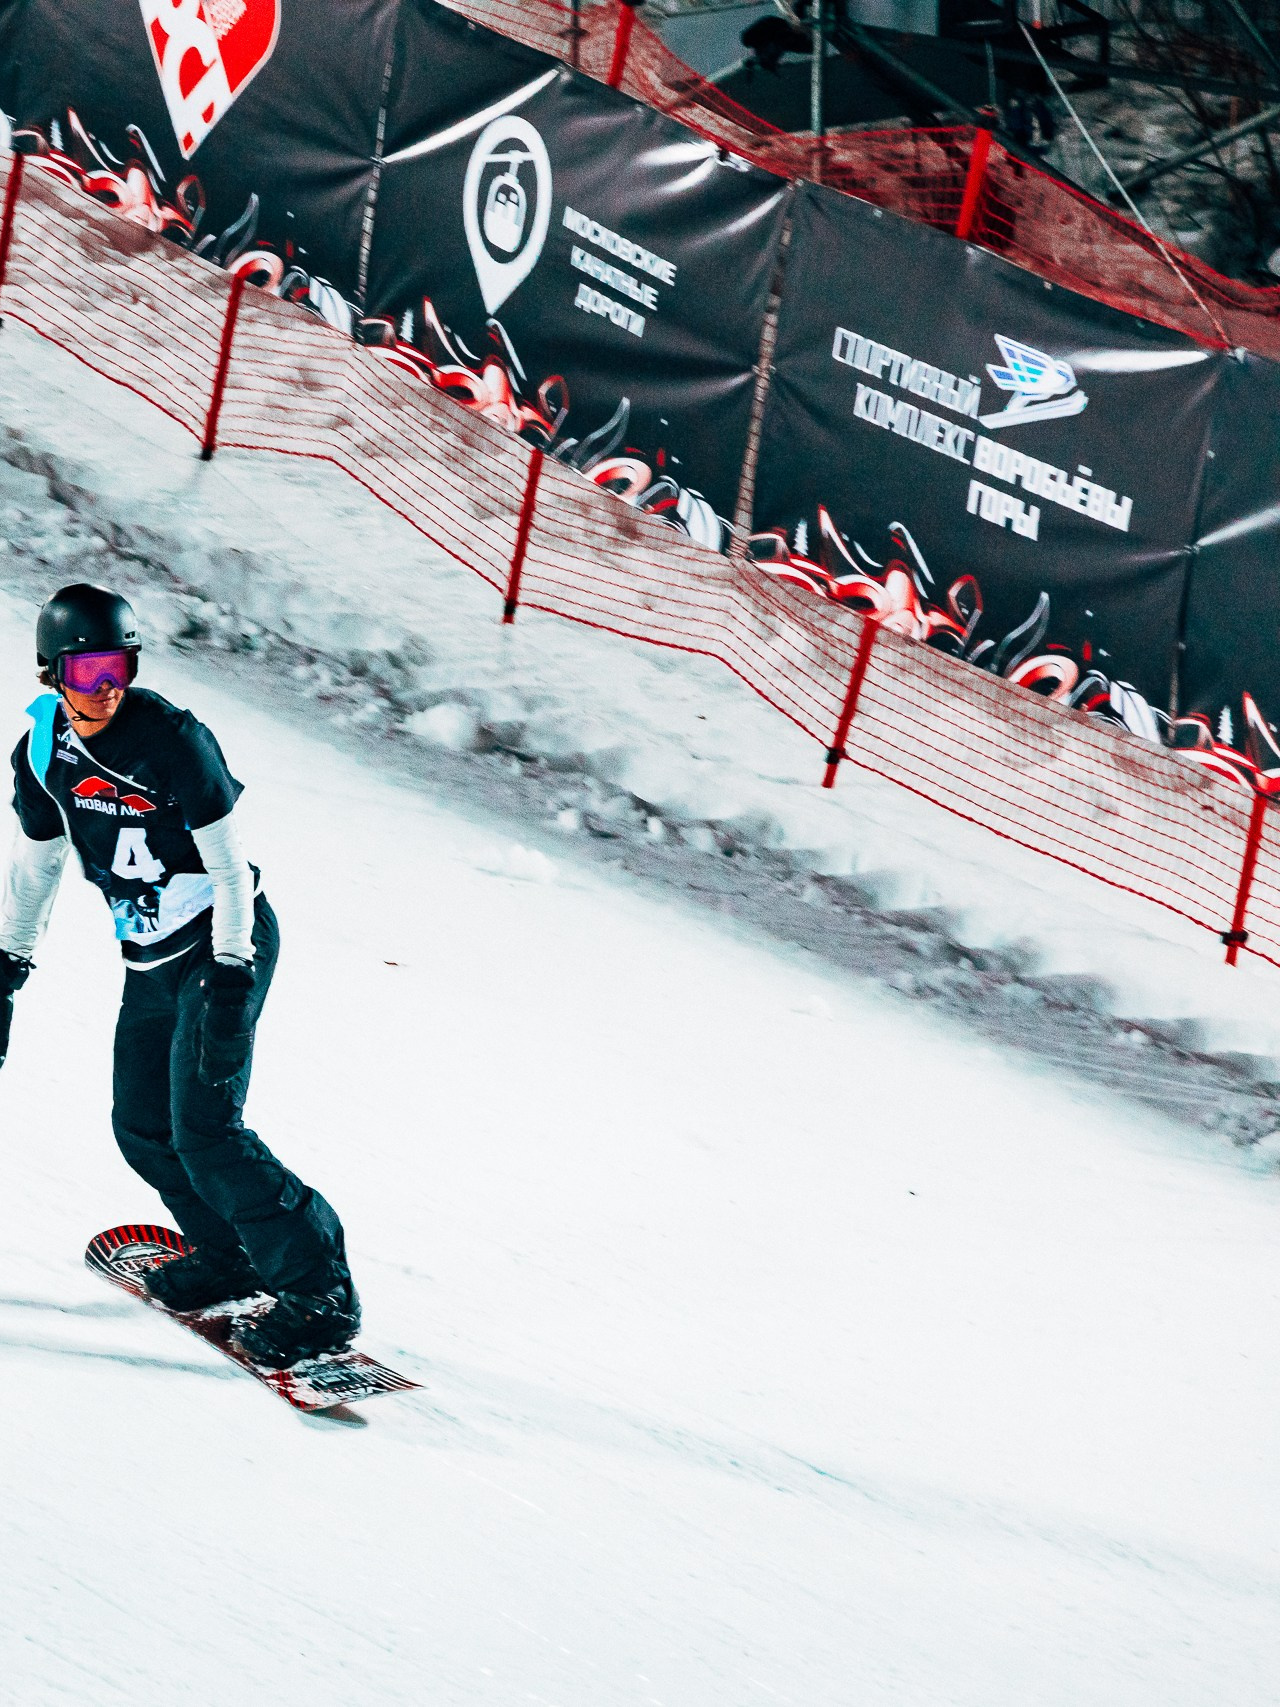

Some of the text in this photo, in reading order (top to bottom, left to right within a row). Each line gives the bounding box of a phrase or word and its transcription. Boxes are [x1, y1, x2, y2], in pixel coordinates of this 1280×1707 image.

[562, 206, 677, 286] МОСКОВСКИЕ
[574, 282, 646, 338] ДОРОГИ
[832, 326, 982, 420] СПОРТИВНЫЙ
[853, 382, 1134, 532] КОМПЛЕКС ВОРОБЬЁВЫ
[967, 479, 1041, 542] ГОРЫ
[74, 796, 117, 816] НОВАЯ
[110, 827, 167, 883] 4
